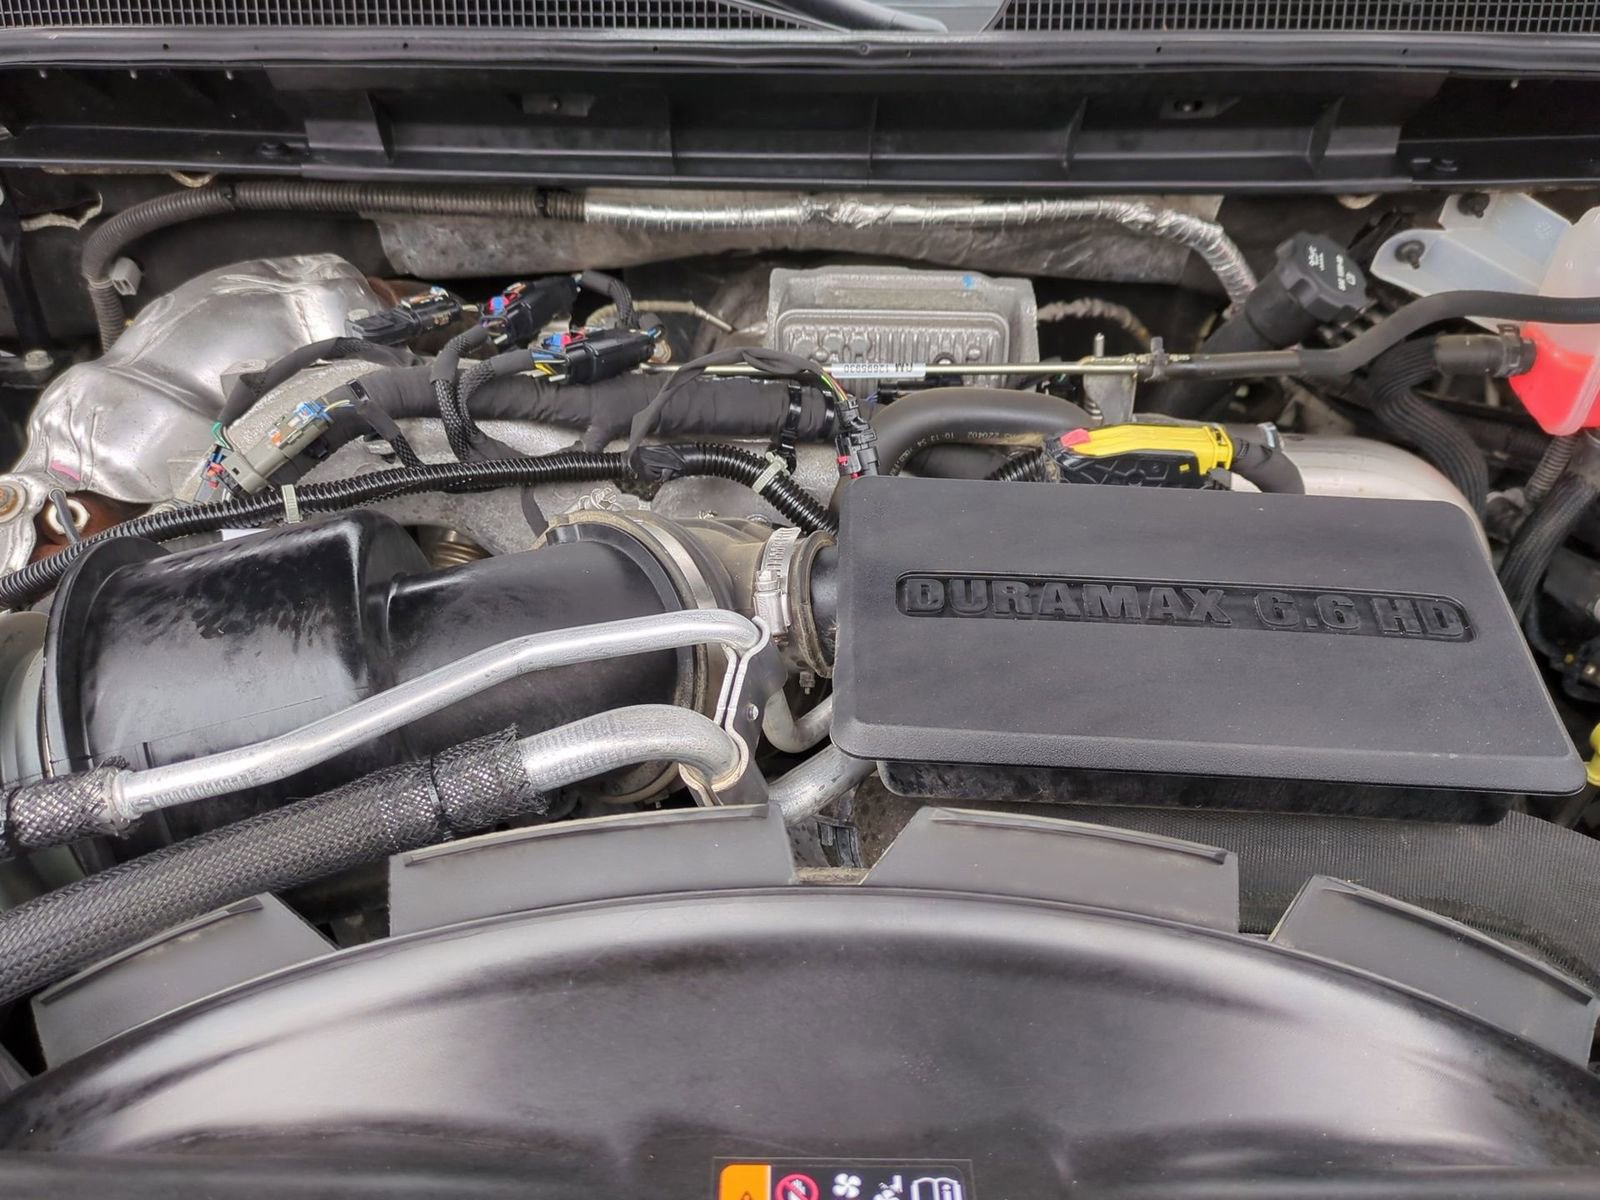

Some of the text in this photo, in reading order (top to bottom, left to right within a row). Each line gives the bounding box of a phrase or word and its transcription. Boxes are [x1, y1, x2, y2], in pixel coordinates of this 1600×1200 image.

[904, 577, 1465, 638] DURAMAX 6.6 HD
